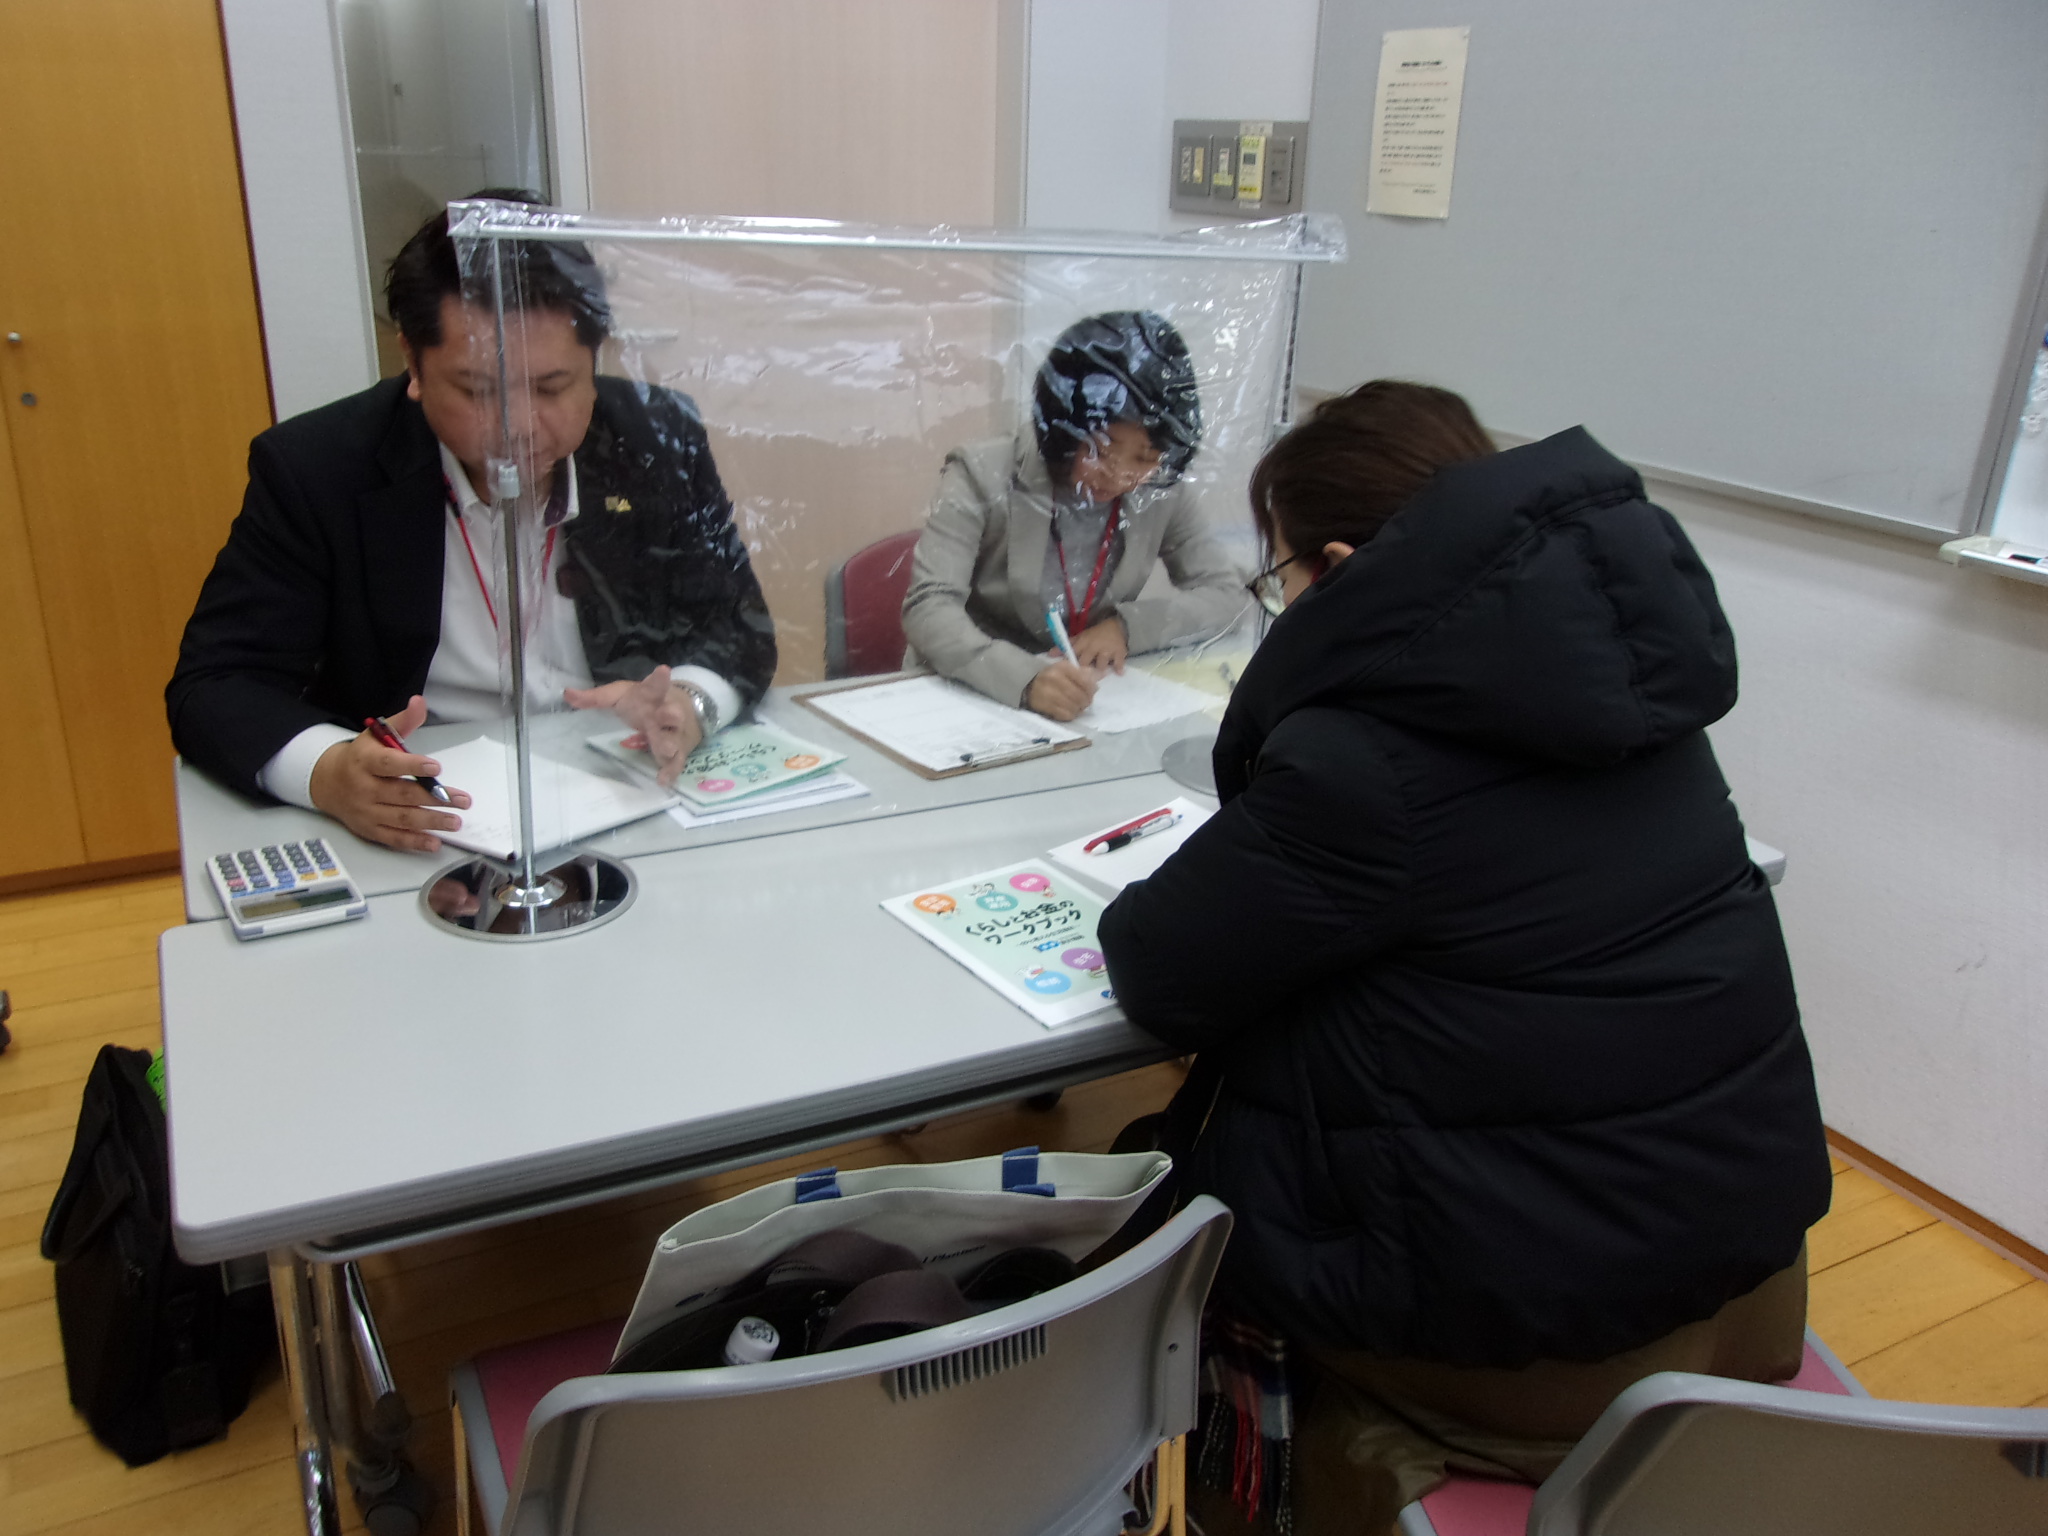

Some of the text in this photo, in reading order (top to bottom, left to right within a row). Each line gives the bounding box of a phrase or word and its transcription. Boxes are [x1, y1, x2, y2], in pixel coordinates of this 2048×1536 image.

[966, 900, 1075, 936] くらしとお金の
[985, 909, 1082, 945] ワークブック
